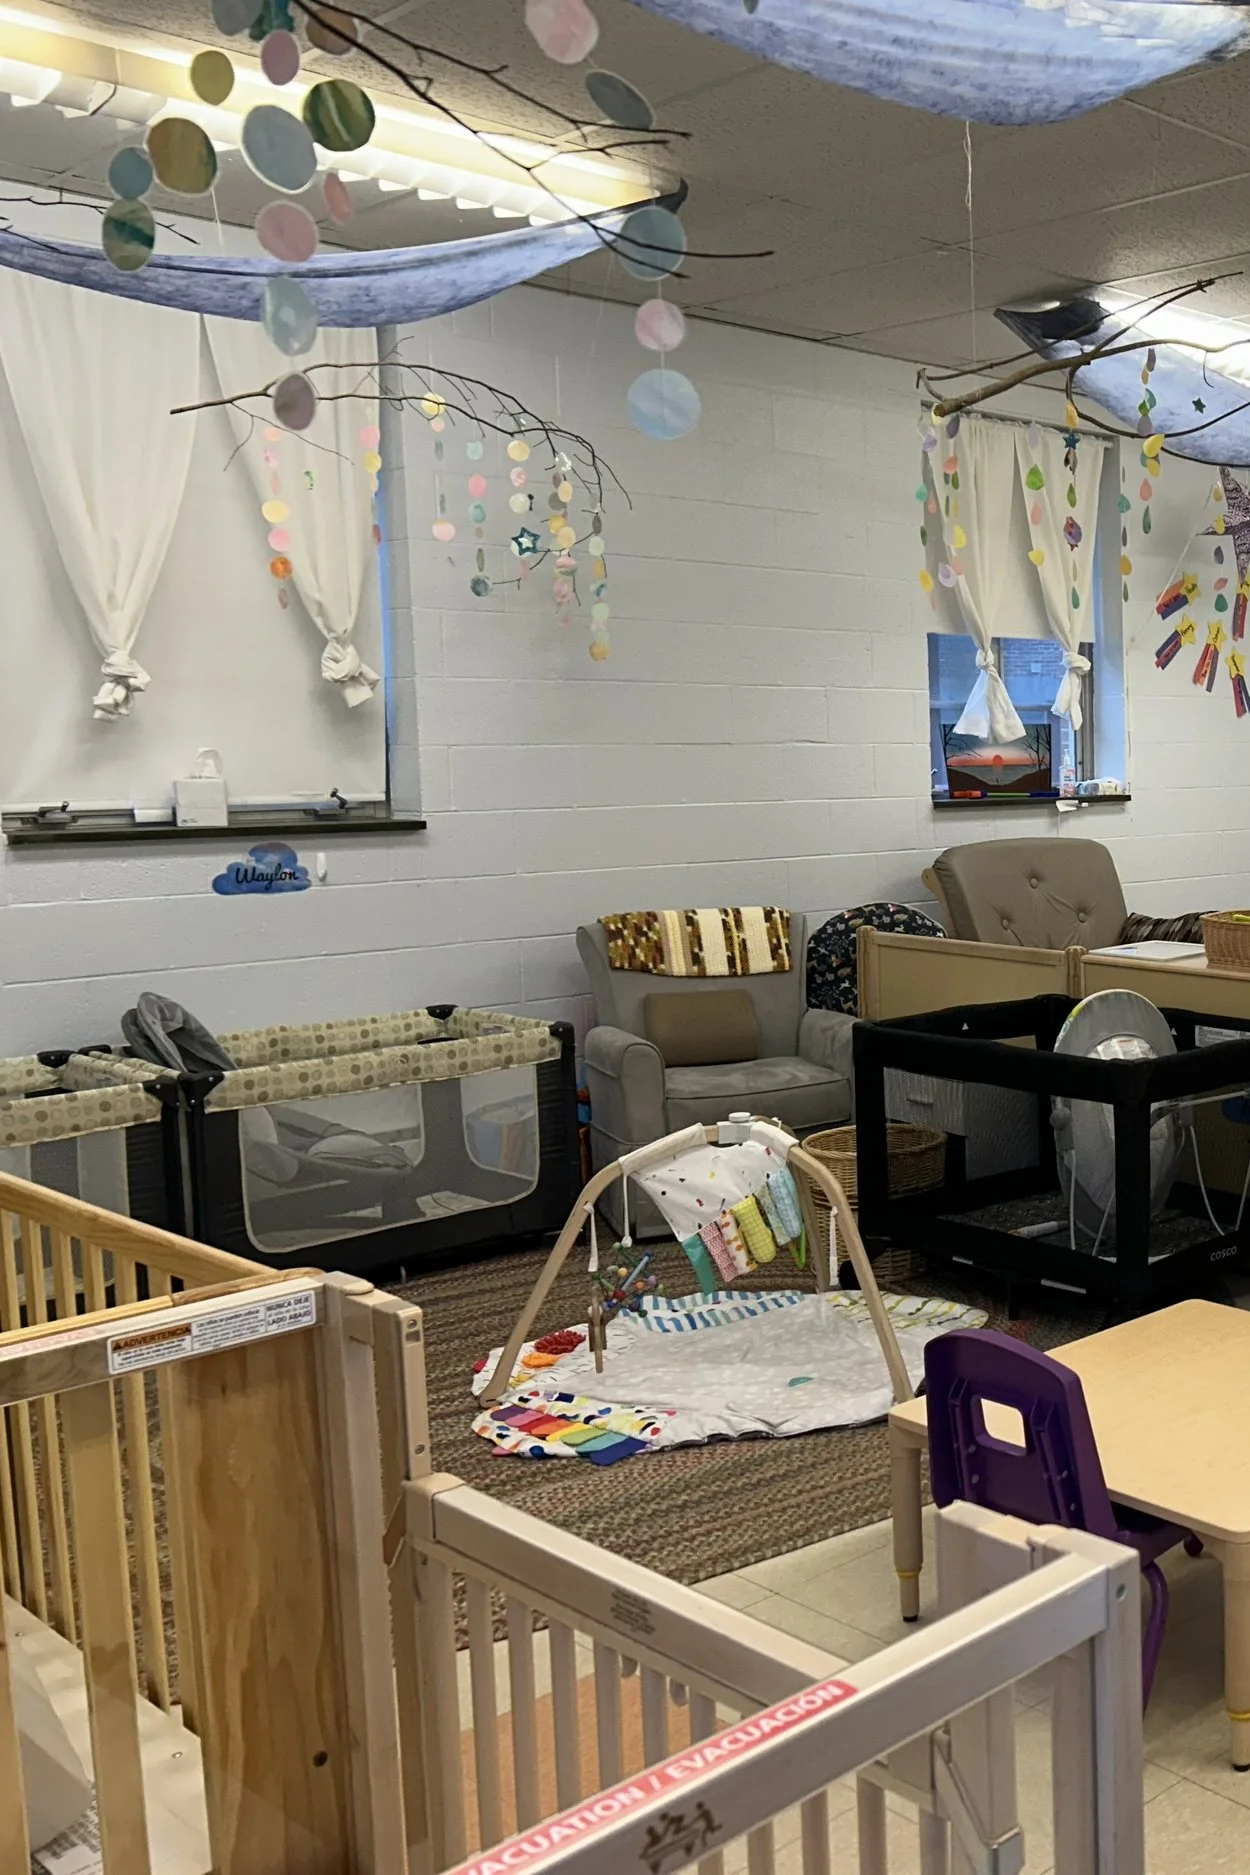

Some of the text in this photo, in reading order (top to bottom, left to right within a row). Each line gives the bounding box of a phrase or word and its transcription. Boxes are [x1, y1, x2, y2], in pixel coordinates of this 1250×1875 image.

[235, 863, 298, 890] Waylon
[1210, 1245, 1238, 1261] COSCO
[266, 1300, 292, 1312] NUNCA
[293, 1296, 310, 1305] DEJE
[268, 1315, 288, 1326] LADO
[288, 1309, 312, 1321] ABAJO
[122, 1325, 191, 1349] ADVERTENCIA
[467, 1784, 647, 1875] ACUATION
[664, 1680, 846, 1783] EVACUACIÓN
